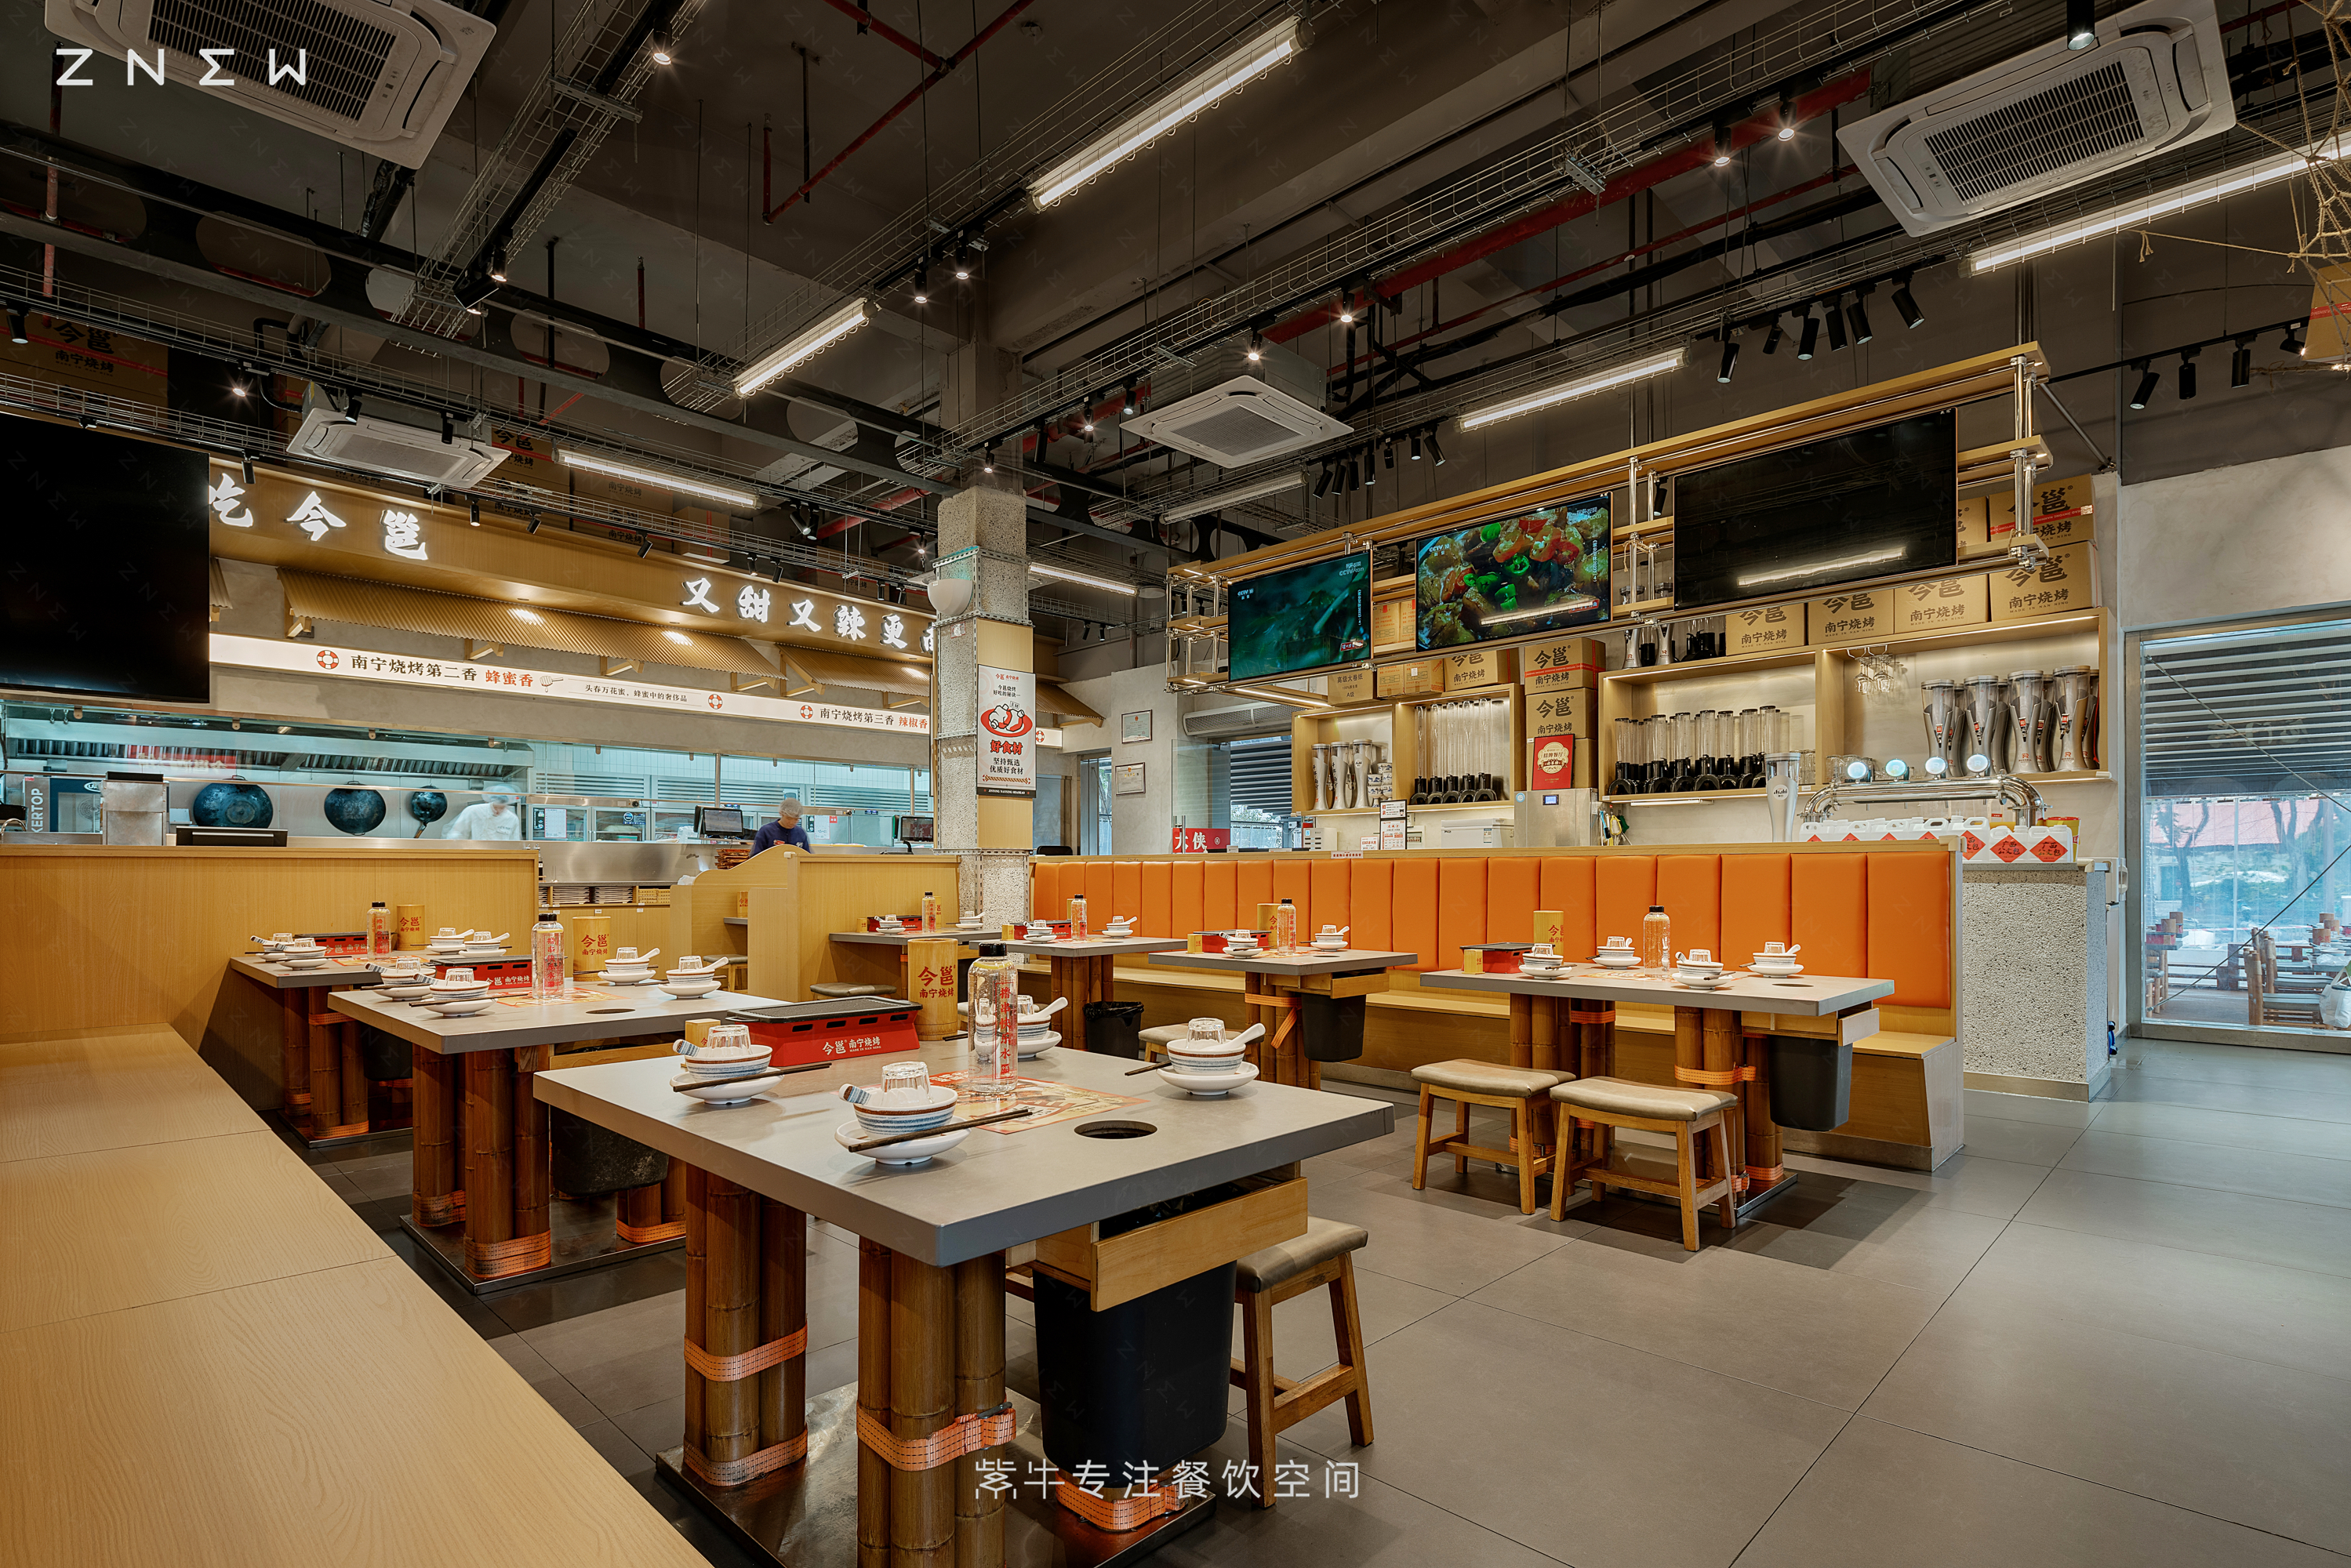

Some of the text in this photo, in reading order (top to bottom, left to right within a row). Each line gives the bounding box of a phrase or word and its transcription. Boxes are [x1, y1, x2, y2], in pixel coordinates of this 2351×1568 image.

[53, 321, 114, 354] 今邕
[56, 350, 114, 373] 南宁烧烤
[609, 481, 641, 497] 南宁烧烤
[2033, 521, 2072, 537] 烧烤
[2009, 588, 2069, 609] 南宁烧烤
[1910, 604, 1965, 622] 南宁烧烤
[1825, 616, 1875, 633] 南宁烧烤
[1742, 629, 1787, 644] 南宁烧烤
[1534, 646, 1569, 669] 今邕
[351, 655, 533, 688] 南宁烧烤第二香 蜂蜜香
[1337, 673, 1363, 684] 高级大卷纸
[1454, 669, 1485, 682] 南宁烧烤
[1535, 671, 1570, 685] 南宁烧烤
[1536, 698, 1572, 718] 今邕
[820, 708, 928, 729] 南宁烧烤第三香 辣椒香
[1537, 721, 1573, 735] 南宁烧烤
[990, 739, 1023, 755] 好食材
[994, 757, 1020, 766] 坚持甄选
[990, 765, 1023, 775] 优质好食材
[400, 916, 421, 927] 今邕
[1269, 916, 1277, 924] 今
[581, 935, 608, 948] 今邕
[918, 966, 954, 986] 今邕
[919, 988, 954, 998] 南宁烧烤
[999, 987, 1012, 1059] 撸串快乐水
[823, 1036, 881, 1055] 今邕 南宁烧烤
